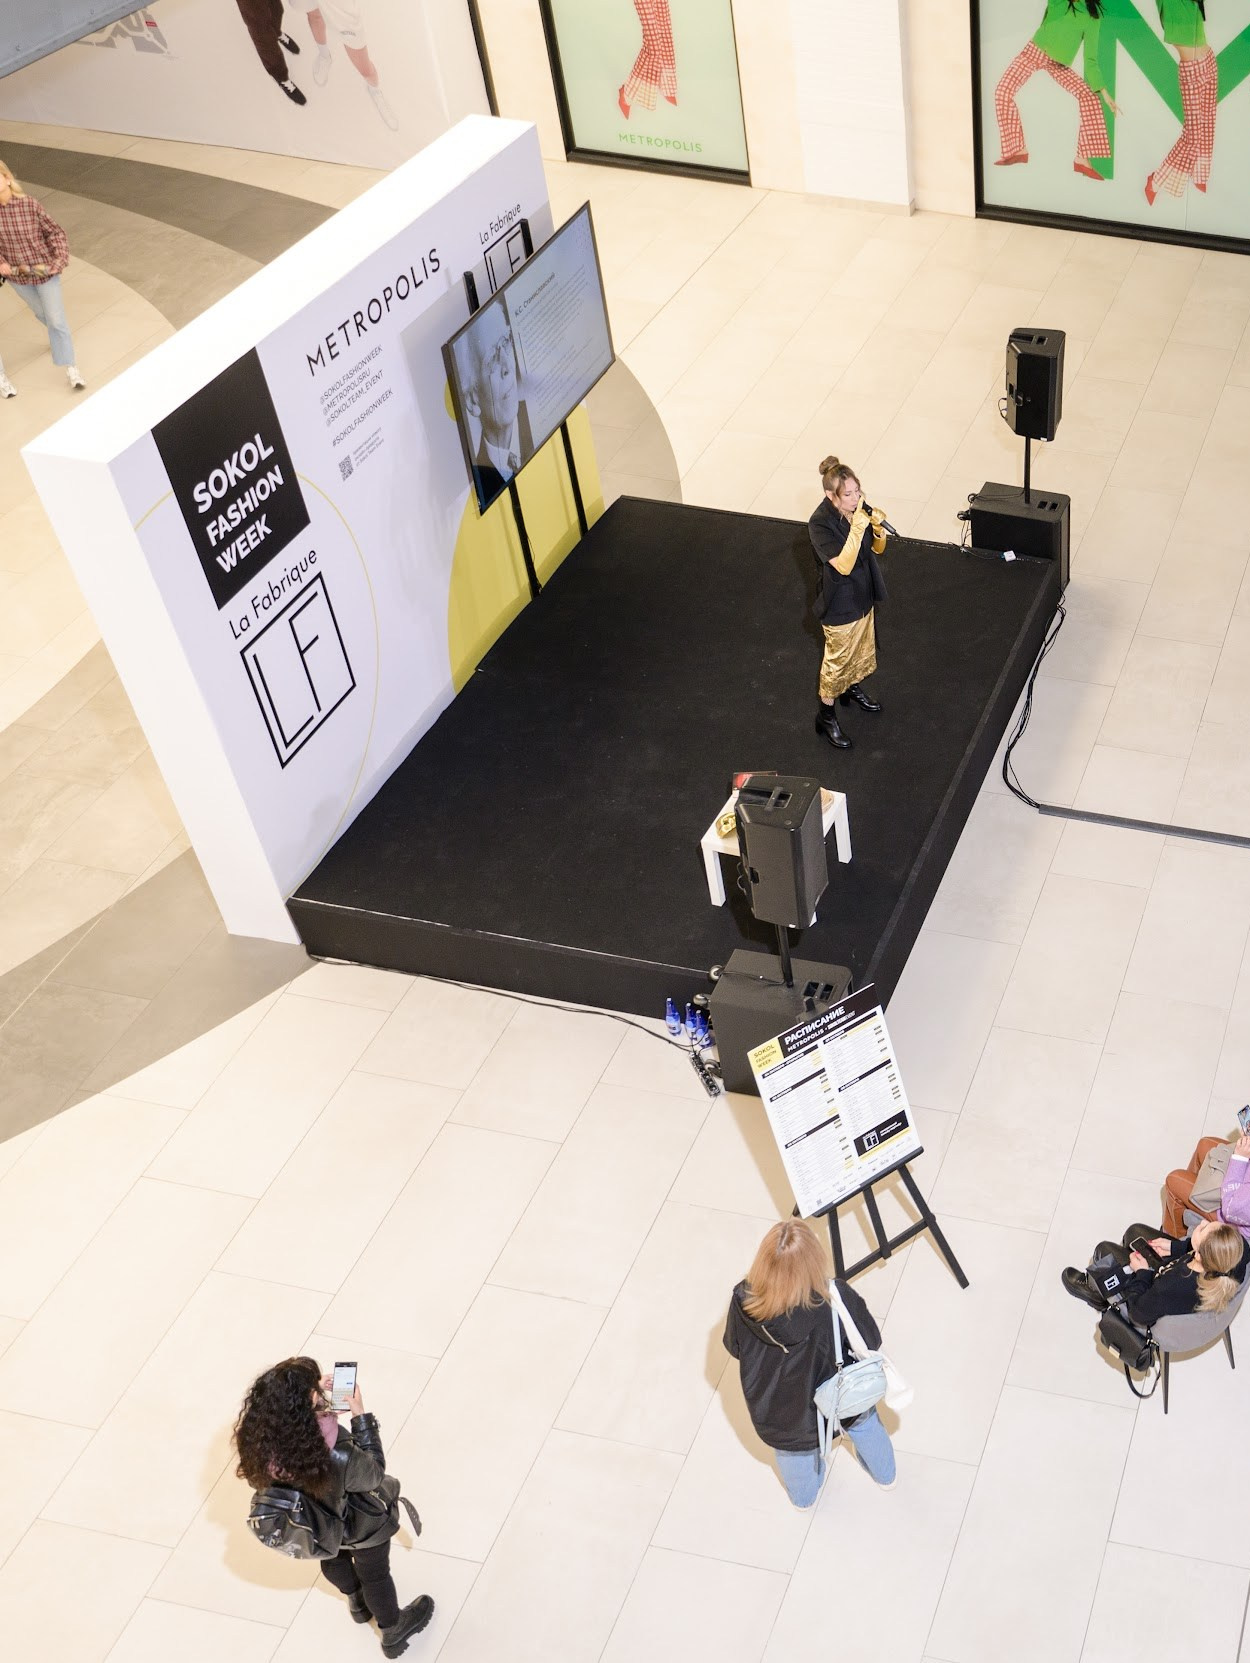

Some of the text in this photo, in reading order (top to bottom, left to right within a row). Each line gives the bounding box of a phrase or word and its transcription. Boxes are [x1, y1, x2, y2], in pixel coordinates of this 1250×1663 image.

[618, 133, 703, 153] METROPOLIS
[479, 203, 522, 245] La Fabrique
[306, 248, 441, 377] METROPOLIS
[320, 344, 383, 404] @SOKOLFASHIONWEEK
[323, 368, 371, 416] @METROPOLISRU
[326, 369, 384, 427] @SOKOLTEAM_EVENT
[332, 388, 393, 447] #SOKOLFASHIONWEEK
[192, 433, 275, 514] SOKOL
[205, 464, 285, 547] FASHION
[215, 513, 273, 574] WEEK
[228, 548, 318, 640] La Fabrique
[753, 1043, 775, 1058] SOKOL
[784, 1006, 846, 1046] РАСПИСАНИЕ
[787, 1028, 825, 1053] METROPOLIS
[755, 1049, 777, 1064] FASHION
[757, 1059, 772, 1069] WEEK
